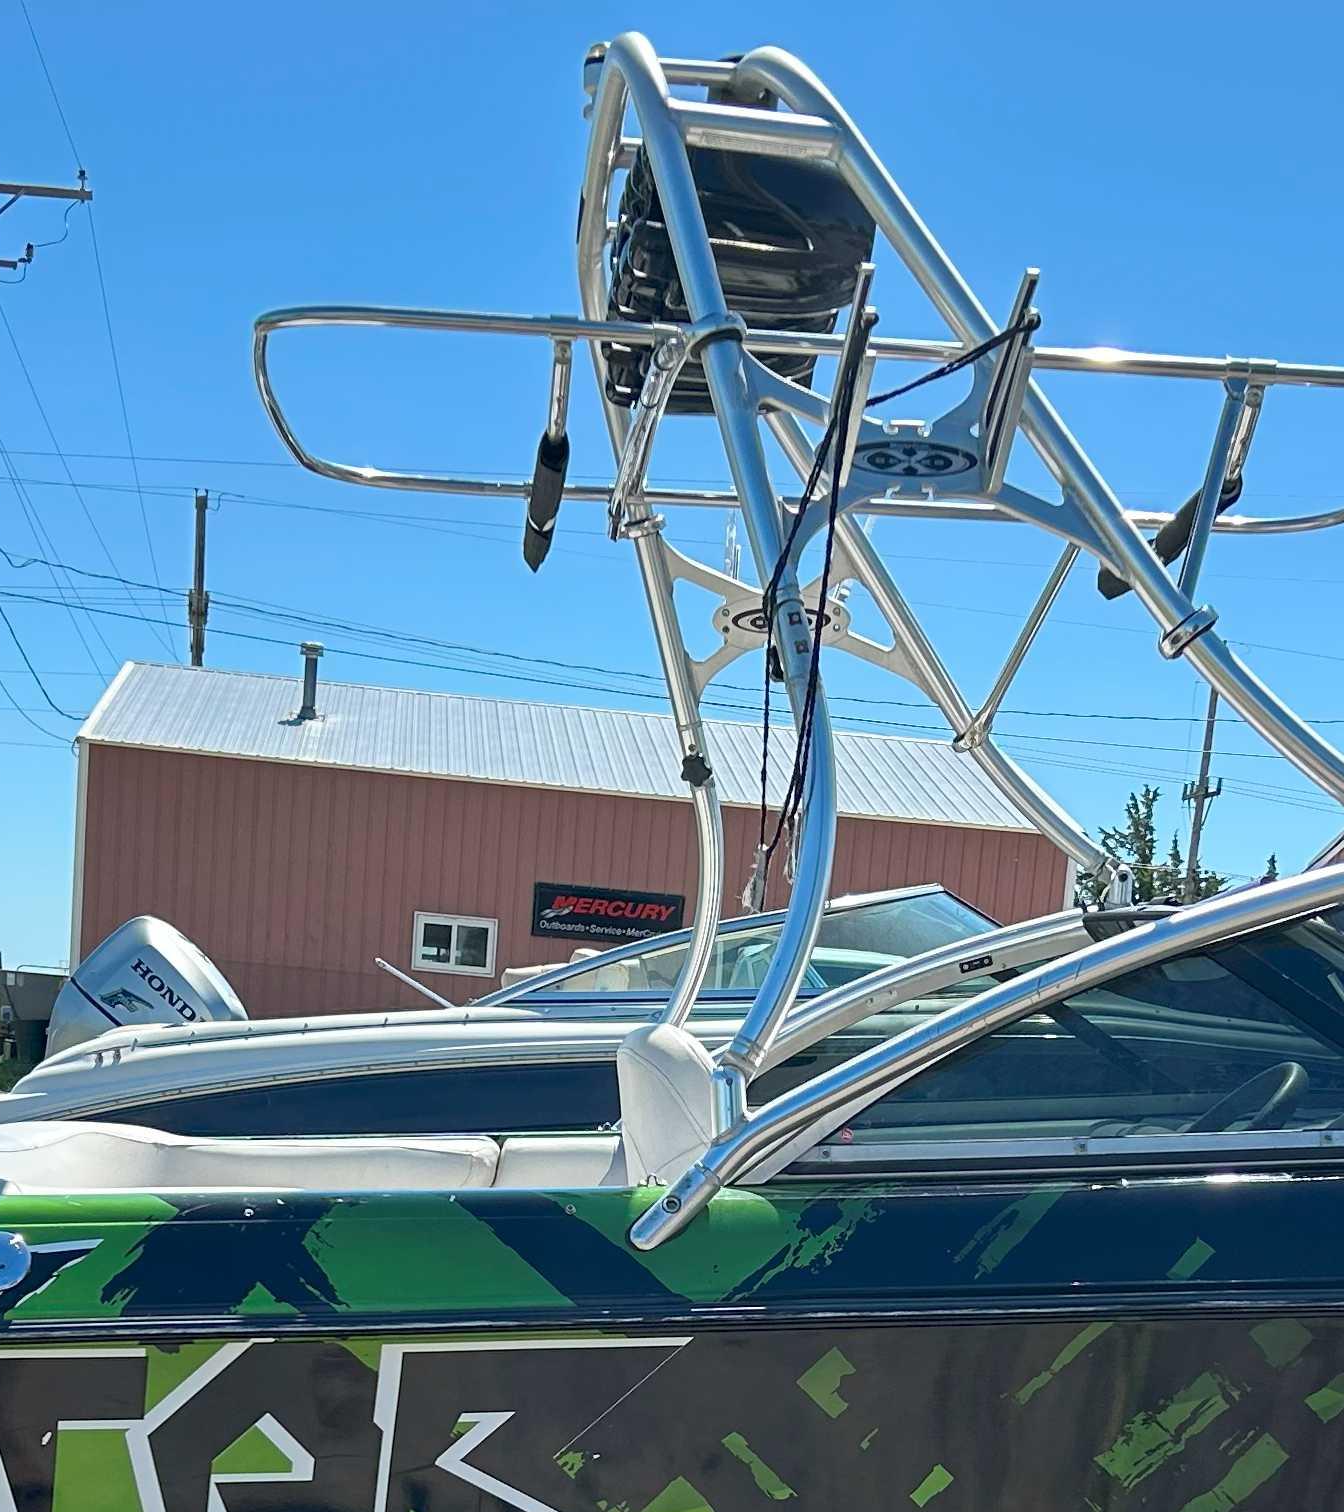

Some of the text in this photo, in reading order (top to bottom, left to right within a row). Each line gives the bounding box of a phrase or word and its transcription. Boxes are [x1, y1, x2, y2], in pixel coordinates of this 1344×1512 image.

[551, 895, 676, 922] MERCURY
[539, 919, 586, 932] Outboards
[589, 925, 623, 936] Service
[130, 957, 207, 1022] HOND
